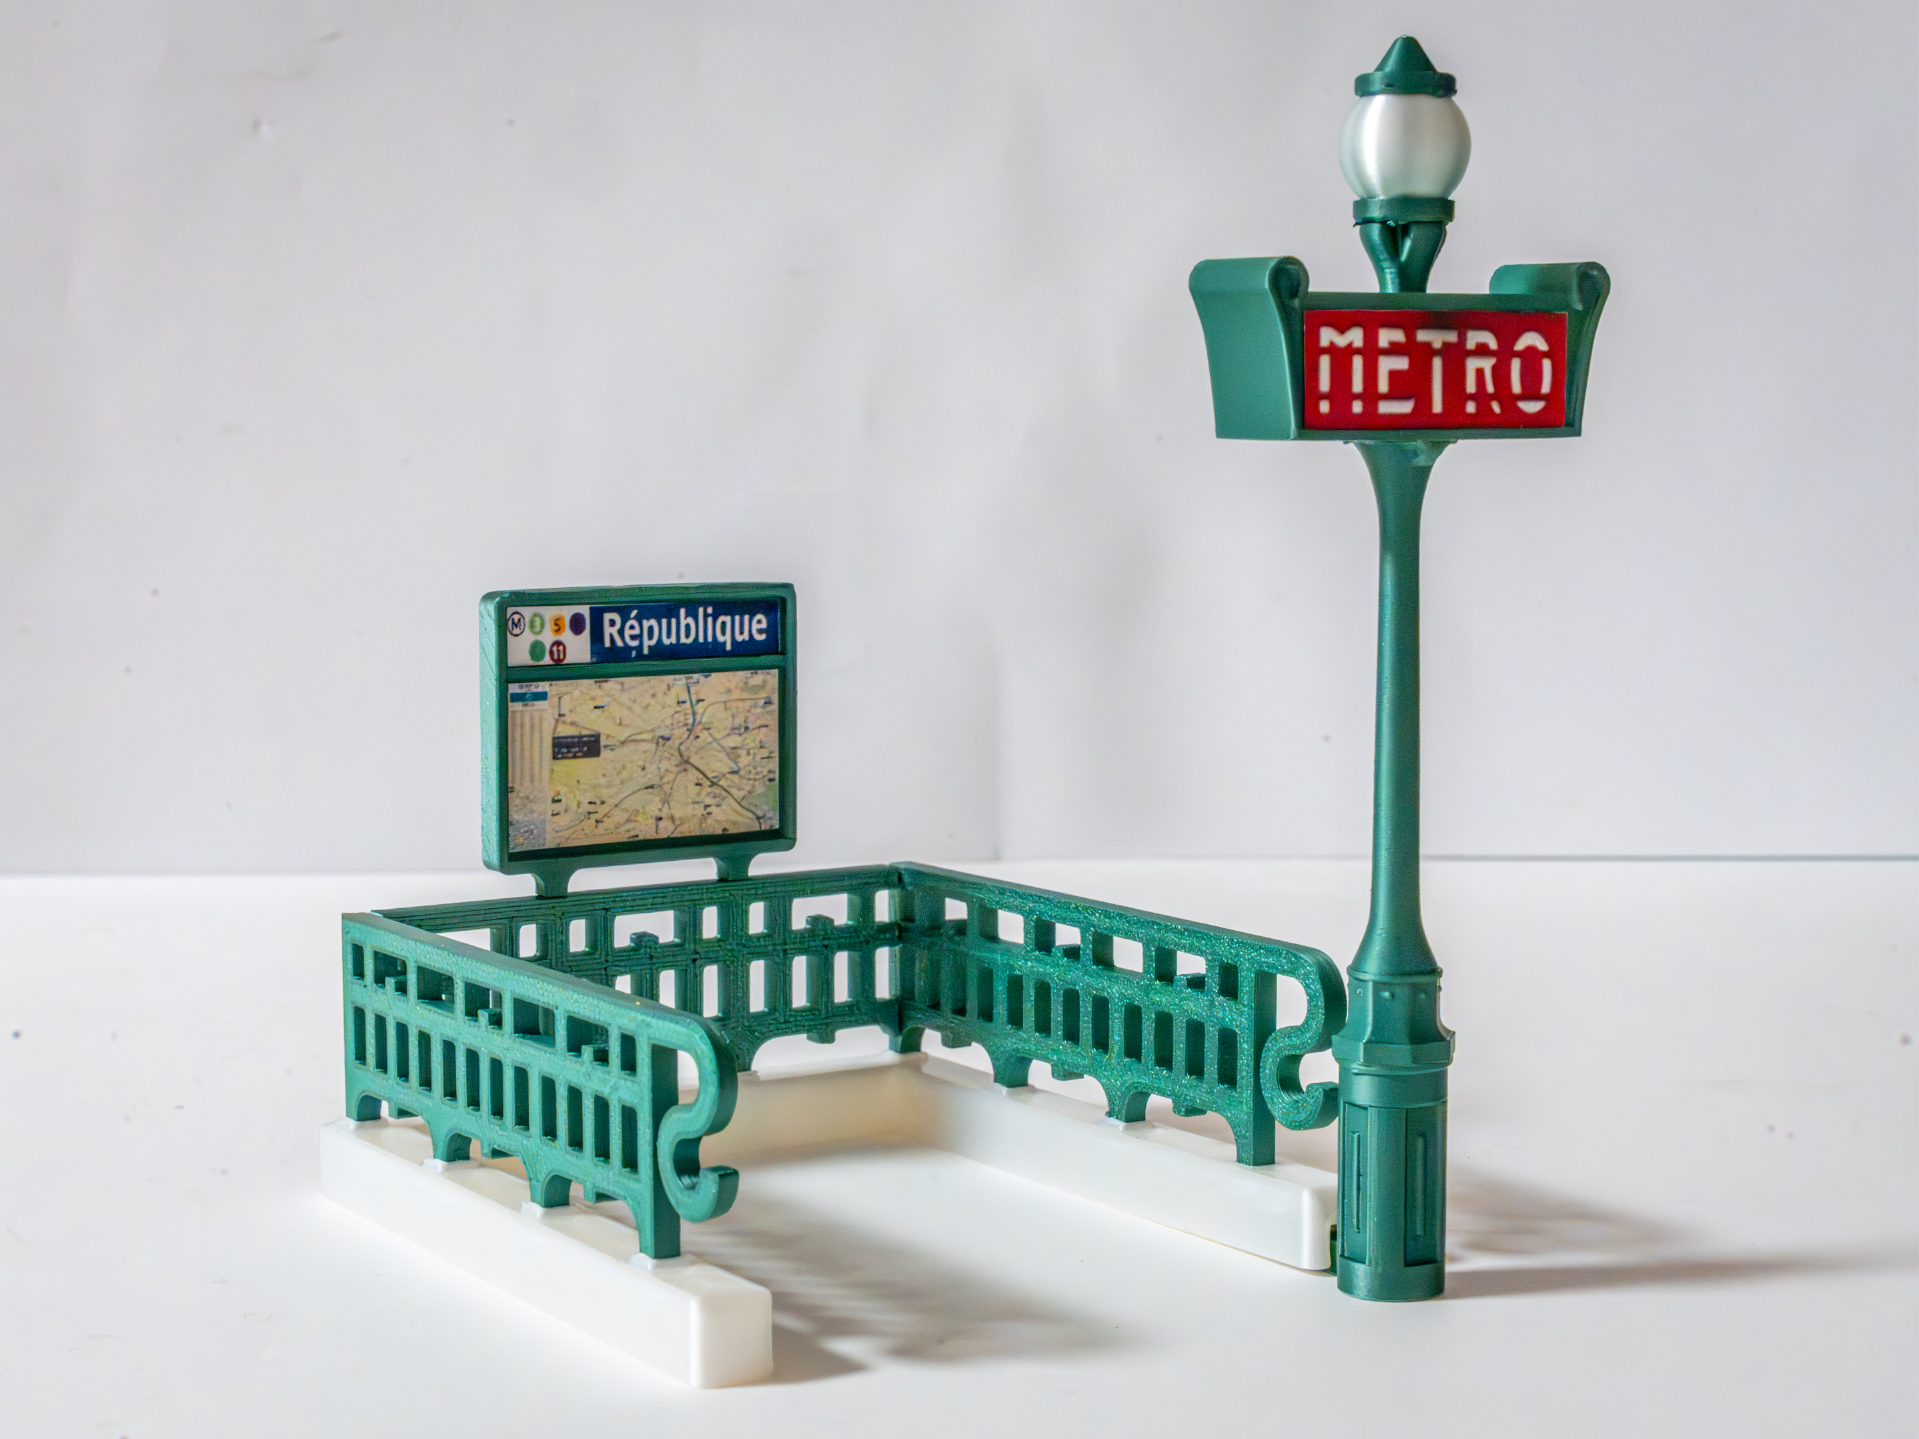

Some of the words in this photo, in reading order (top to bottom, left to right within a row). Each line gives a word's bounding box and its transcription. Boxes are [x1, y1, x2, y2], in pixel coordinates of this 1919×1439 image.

[1318, 325, 1552, 414] METRO
[551, 644, 564, 660] 11
[602, 606, 768, 655] République
